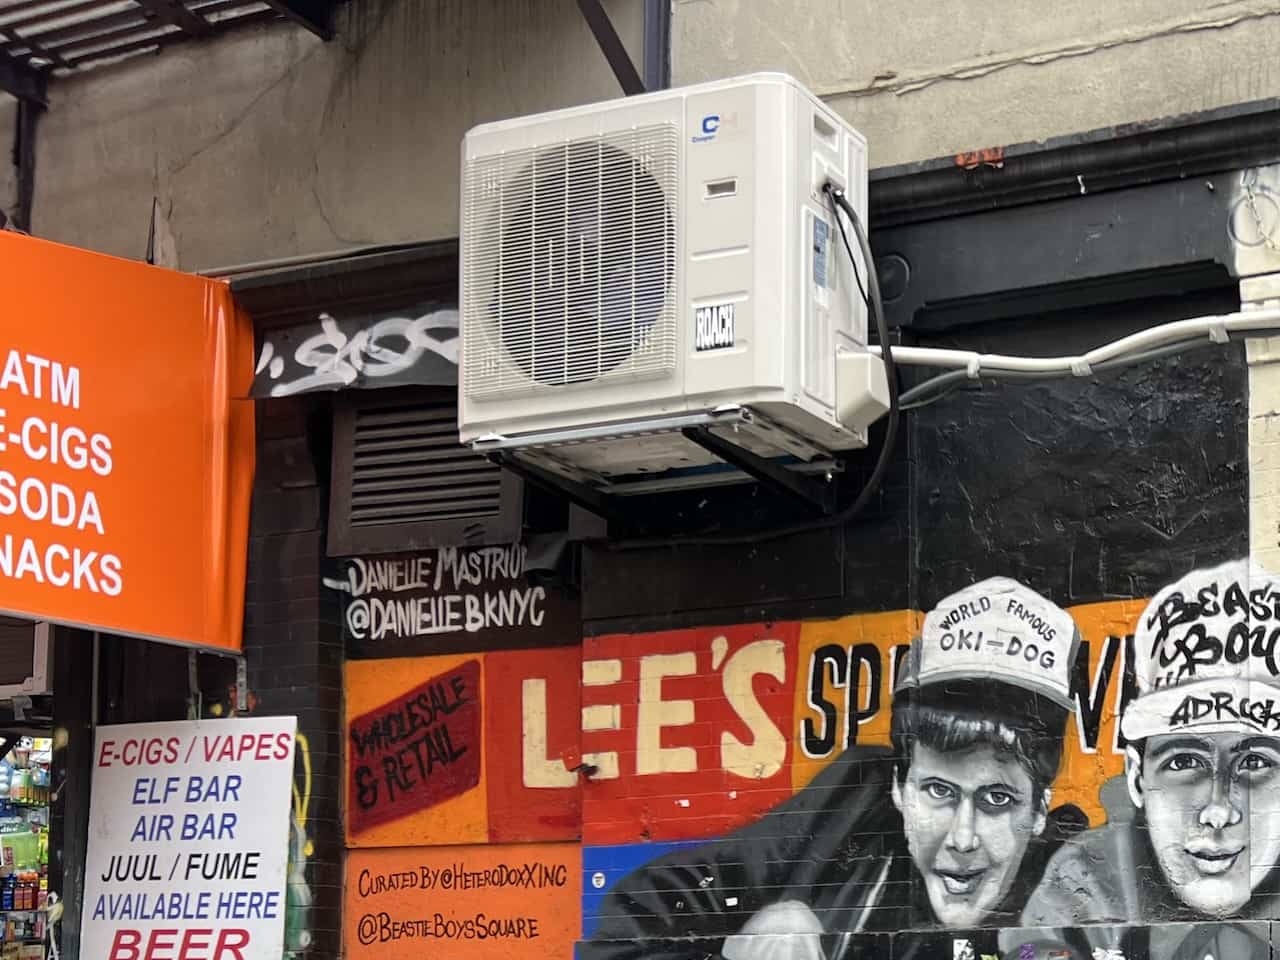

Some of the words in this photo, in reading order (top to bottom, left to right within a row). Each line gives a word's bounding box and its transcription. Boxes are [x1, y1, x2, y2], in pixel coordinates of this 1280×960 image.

[696, 304, 734, 352] ROACH
[0, 349, 80, 409] ATM
[0, 470, 105, 535] SODA
[347, 557, 432, 597] DANIELLE
[939, 596, 991, 631] WORLD
[1007, 600, 1056, 642] FAMOUS
[940, 629, 1055, 669] OKI-DOG
[351, 676, 469, 757] WHOLESALE
[522, 636, 786, 788] LEE'S
[99, 736, 180, 767] E-CIGS
[203, 732, 291, 762] VAPES
[355, 765, 378, 810] &
[383, 723, 467, 802] RETAIL
[132, 777, 180, 805] ELF
[185, 775, 242, 803] BAR
[131, 815, 174, 842] AIR
[181, 813, 237, 840] BAR
[101, 854, 162, 882] JUUL
[184, 852, 260, 880] FUME
[358, 868, 418, 898] CURATED
[92, 893, 211, 921] AVAILABLE
[216, 891, 280, 919] HERE
